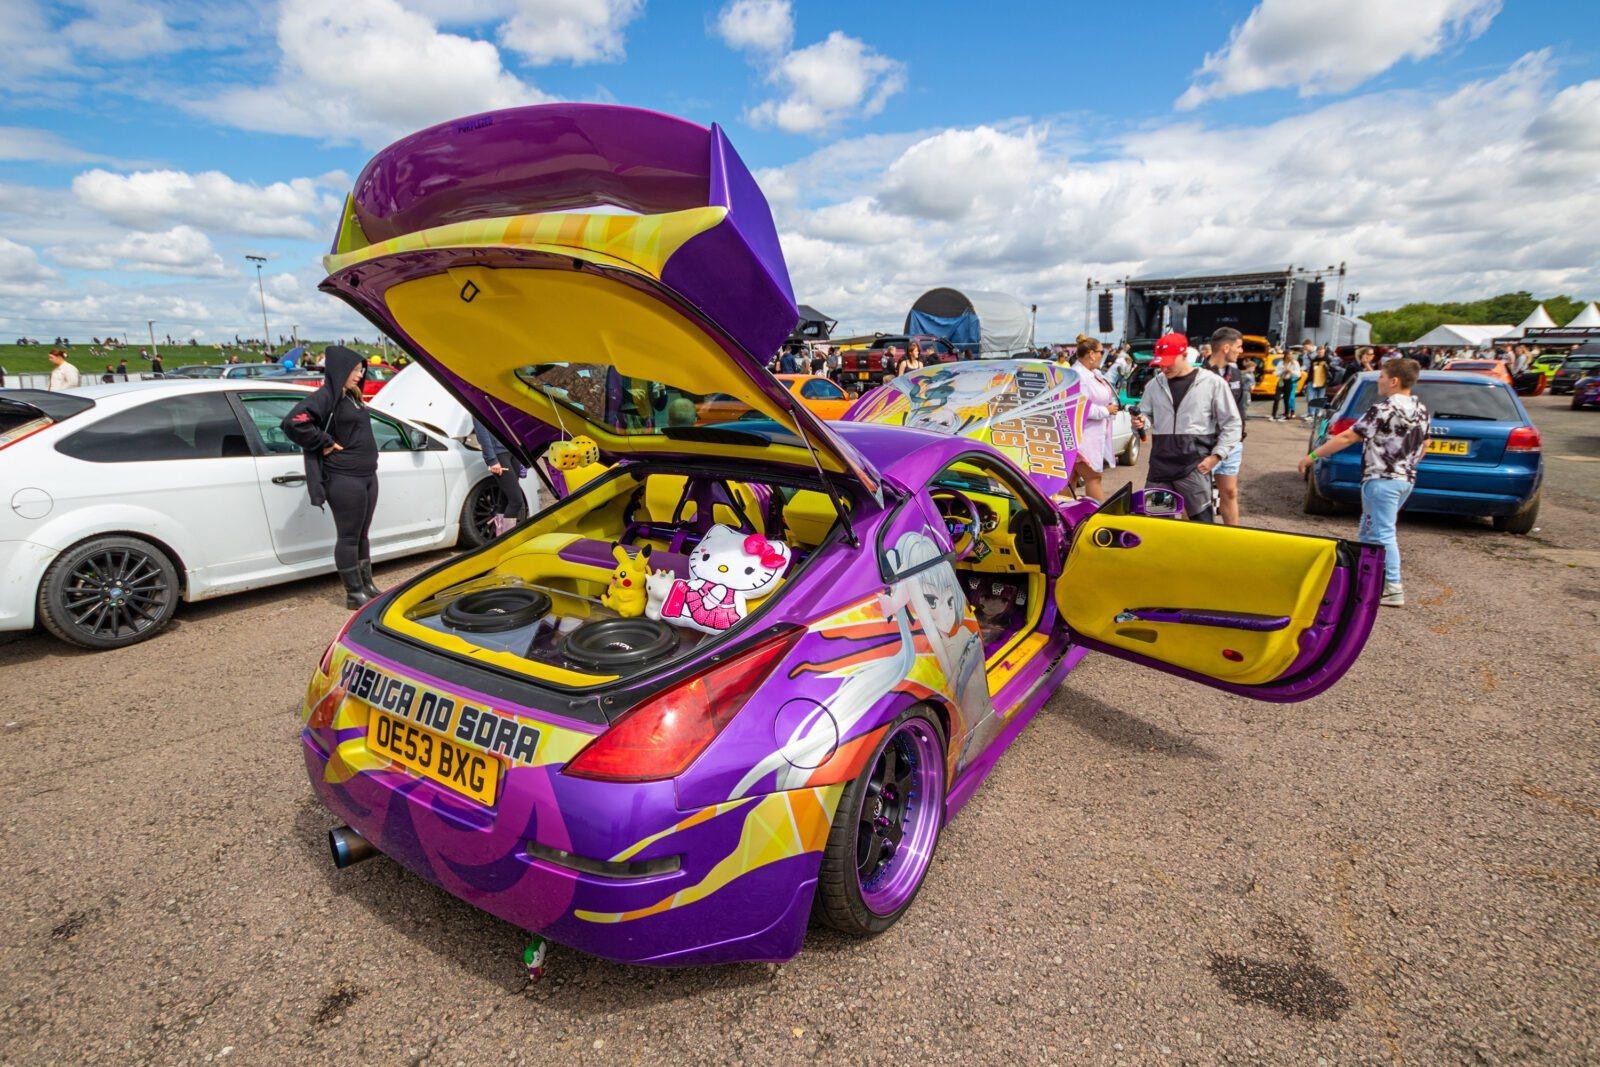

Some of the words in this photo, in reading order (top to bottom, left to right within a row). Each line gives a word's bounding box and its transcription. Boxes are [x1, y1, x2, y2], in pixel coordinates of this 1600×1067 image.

[1440, 441, 1466, 453] FWE
[340, 659, 416, 718] YOSUGA
[417, 692, 455, 733] NO
[455, 706, 541, 764] SORA
[376, 715, 433, 769] OE53
[438, 741, 487, 793] BXG
